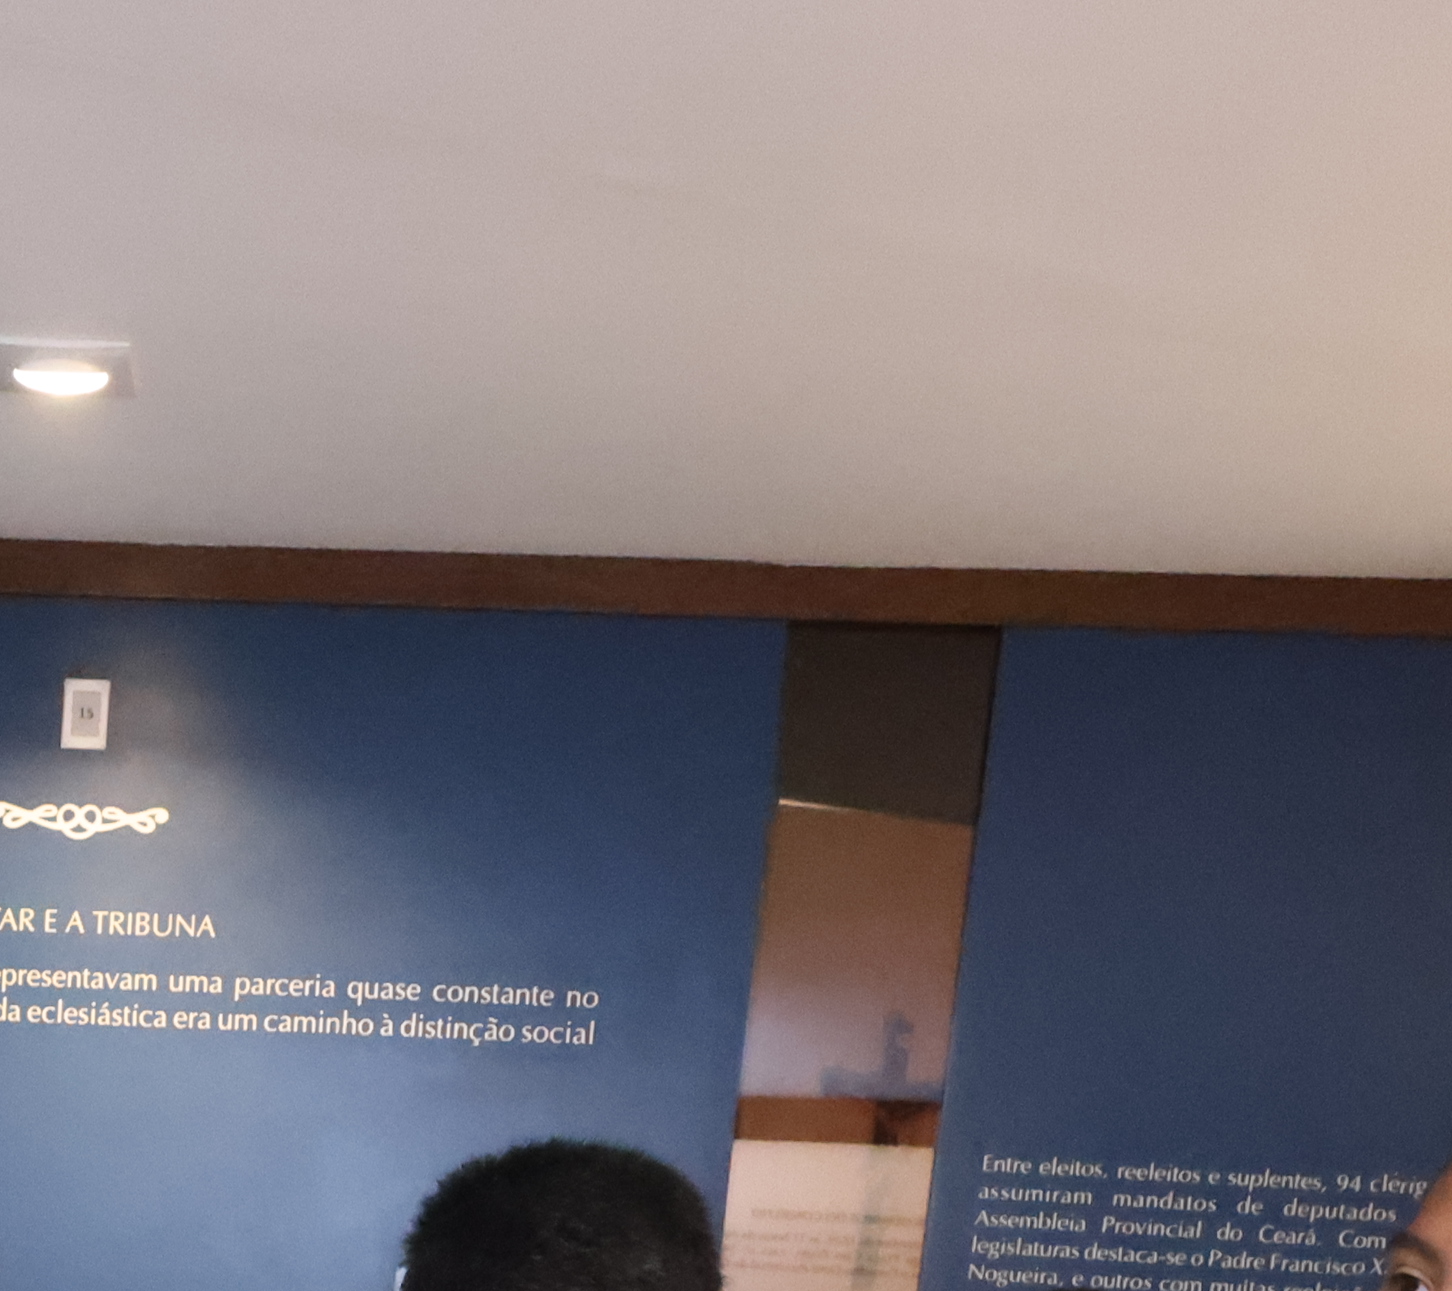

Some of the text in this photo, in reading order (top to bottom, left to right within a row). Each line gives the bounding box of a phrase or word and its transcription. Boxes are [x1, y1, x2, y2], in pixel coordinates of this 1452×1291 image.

[44, 908, 58, 933] E
[64, 910, 85, 934] A
[92, 910, 216, 939] TRIBUNA
[168, 974, 223, 994] uma
[233, 973, 336, 1001] parceria
[346, 980, 422, 1006] quase
[432, 983, 555, 1008] constante
[566, 989, 600, 1009] no
[26, 999, 167, 1029] eclesiástica
[172, 1009, 211, 1030] era
[217, 1012, 257, 1032] um
[263, 1009, 374, 1037] caminho
[379, 1012, 394, 1037] à
[400, 1013, 516, 1046] distinção
[521, 1020, 596, 1045] social
[982, 1153, 1362, 1194] Entre eleitos, reeleitos suplentes, 94
[977, 1184, 1397, 1223] assumiram mandatos de deputados
[973, 1209, 1387, 1250] Assembleia Provincial do Com
[971, 1234, 1081, 1260] legislaturas
[1083, 1242, 1188, 1267] destaca-se
[1207, 1249, 1266, 1271] Padre
[1269, 1252, 1366, 1276] Francisco
[967, 1263, 1064, 1288] Nogueira,
[1089, 1273, 1153, 1291] outros
